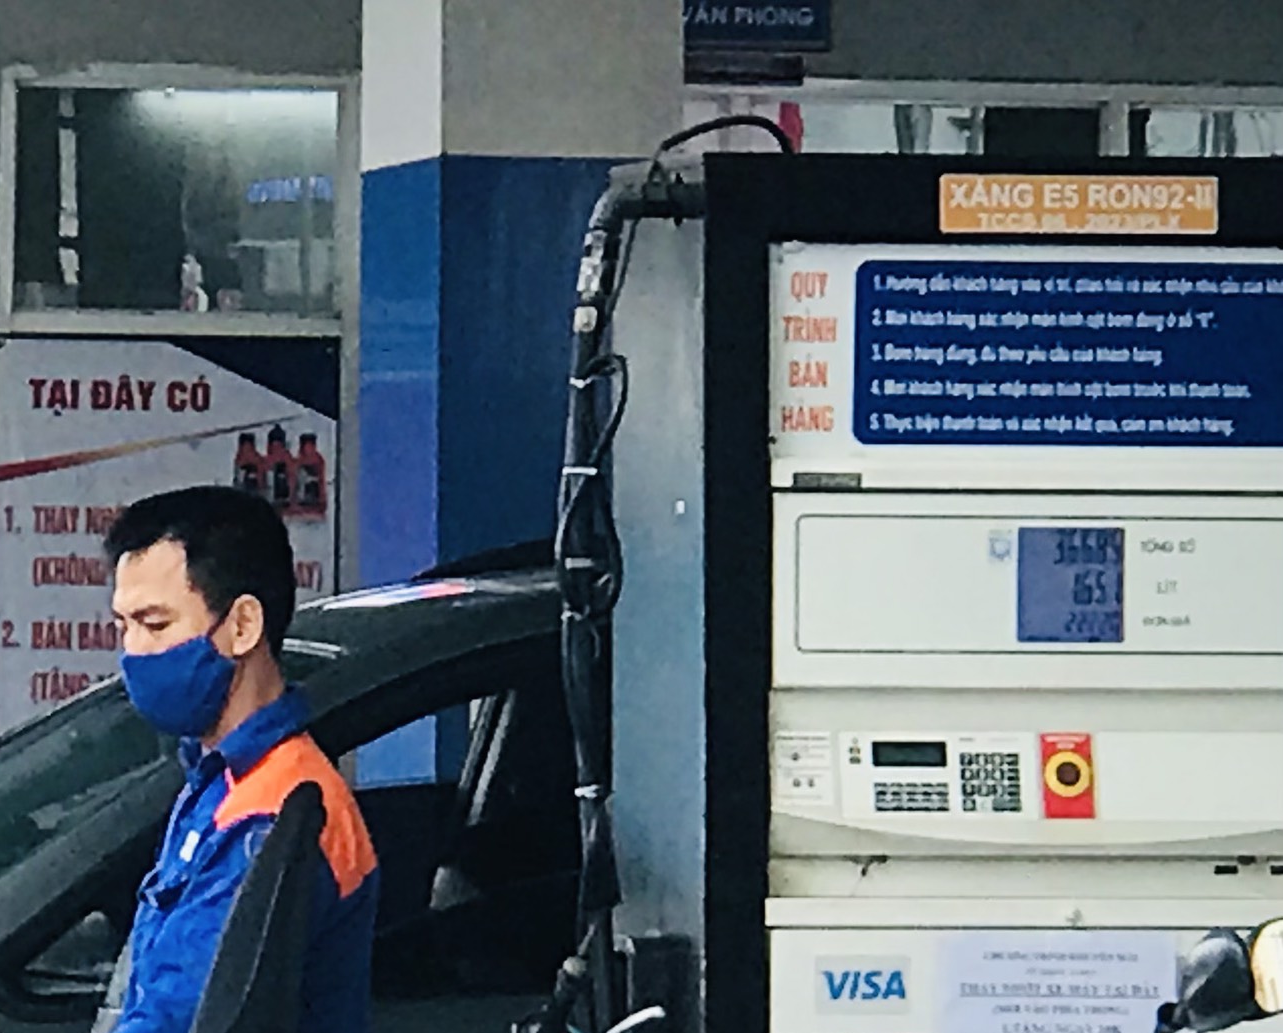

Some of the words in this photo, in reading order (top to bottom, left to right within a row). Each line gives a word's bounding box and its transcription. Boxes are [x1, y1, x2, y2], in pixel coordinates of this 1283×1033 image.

[1042, 183, 1080, 210] E5
[790, 270, 829, 302] QUY
[28, 377, 80, 416] TẠI
[90, 373, 157, 411] ĐÂY
[166, 374, 212, 413] CÓ
[820, 969, 907, 1001] VISA
